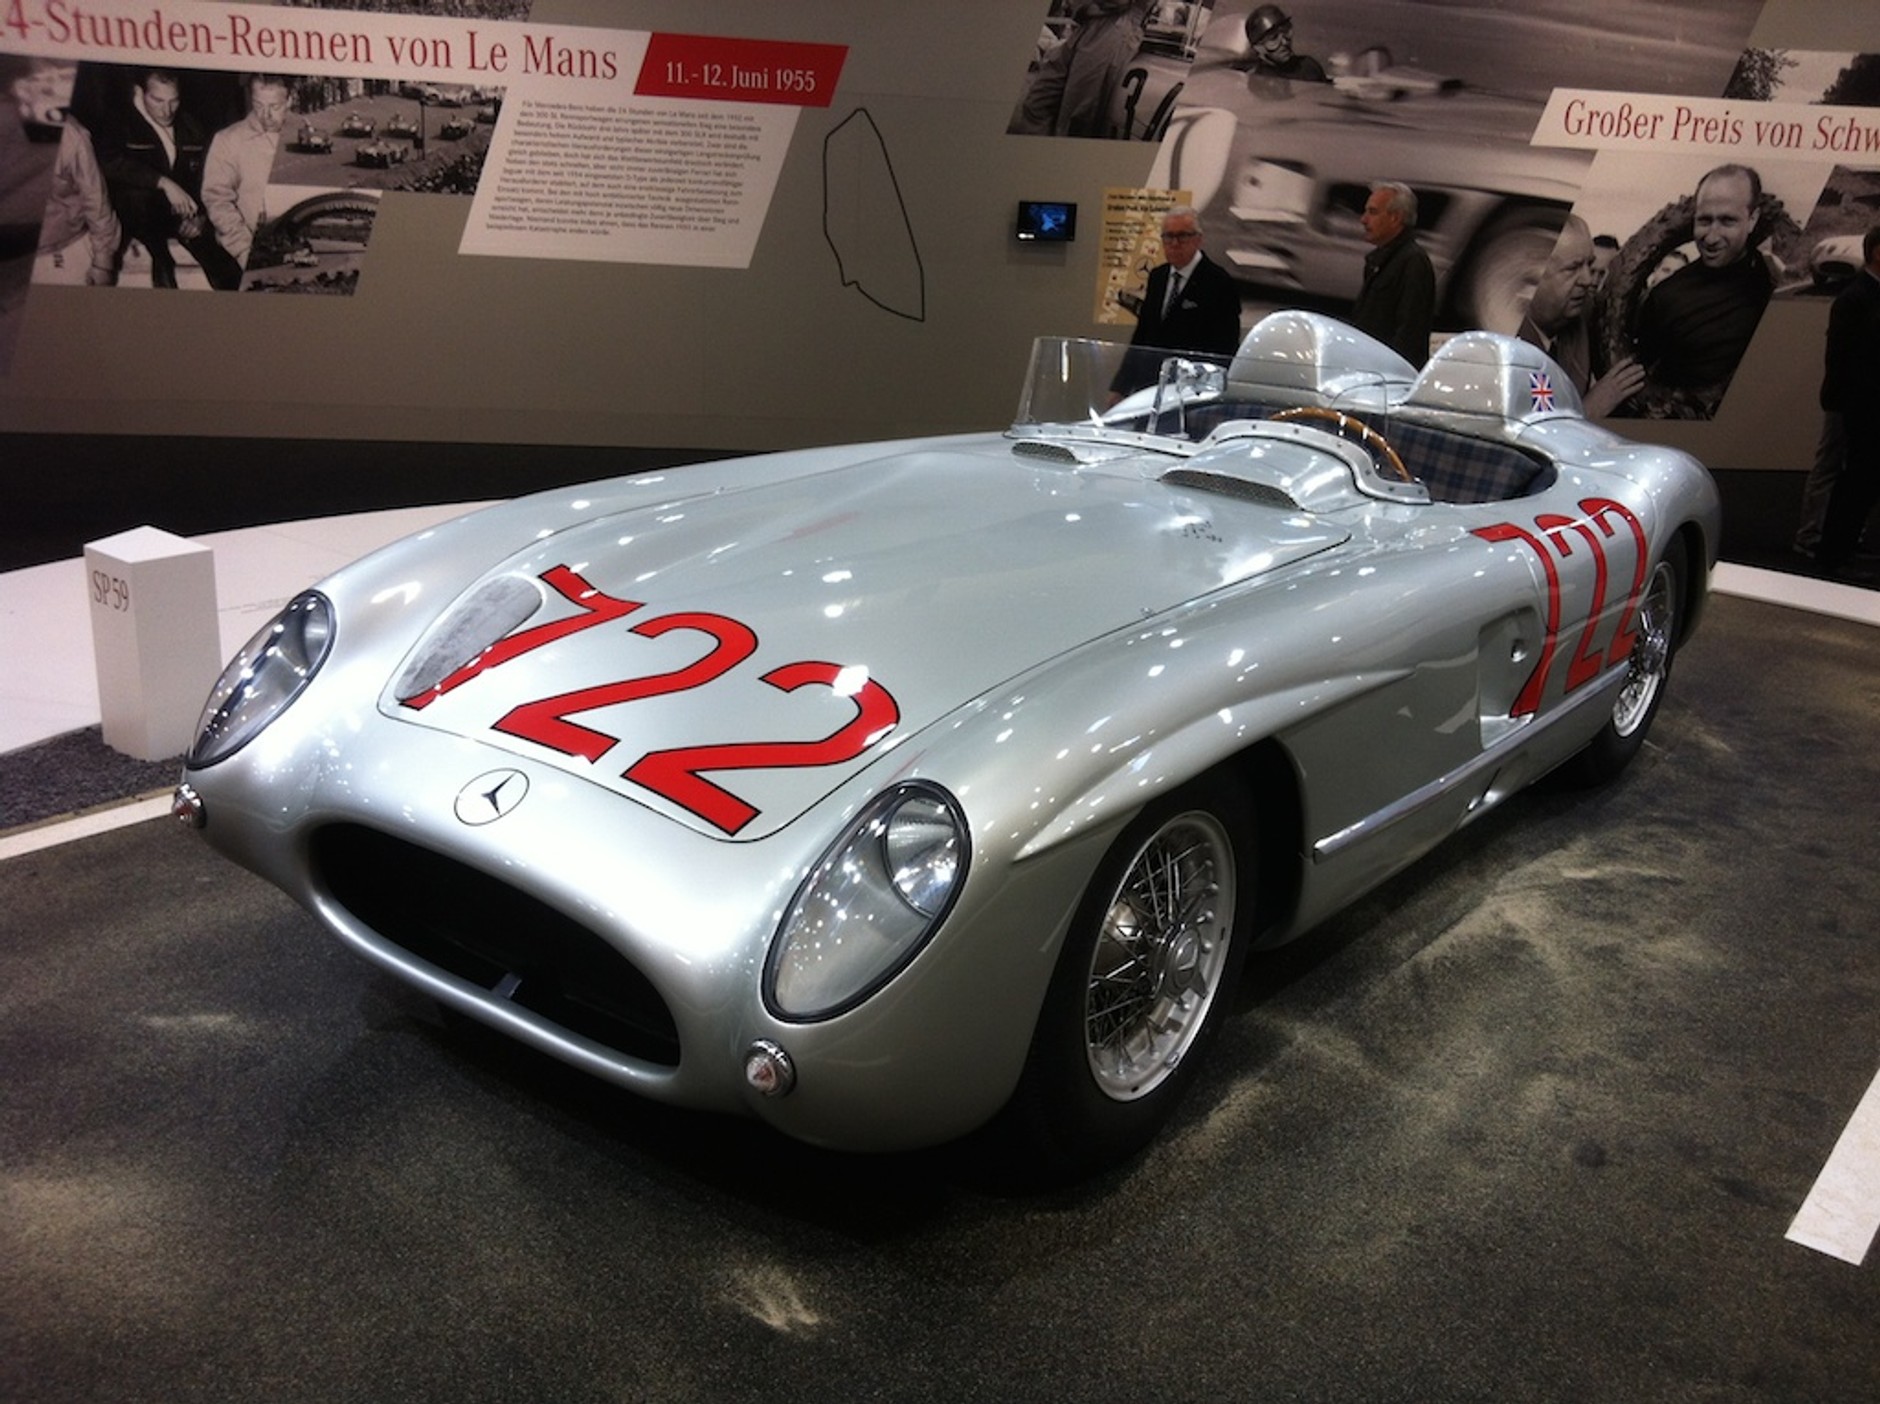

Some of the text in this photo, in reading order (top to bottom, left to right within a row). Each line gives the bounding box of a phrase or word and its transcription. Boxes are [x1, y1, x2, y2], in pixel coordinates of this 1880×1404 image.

[0, 0, 618, 81] 4-Stunden-Rennen von Le Mans
[731, 64, 769, 90] Juni
[776, 68, 817, 93] 1955
[1564, 98, 1665, 140] Großer
[1671, 106, 1745, 146] Preis
[1754, 120, 1804, 149] von
[1470, 497, 1647, 719] 722
[398, 563, 902, 837] 722
